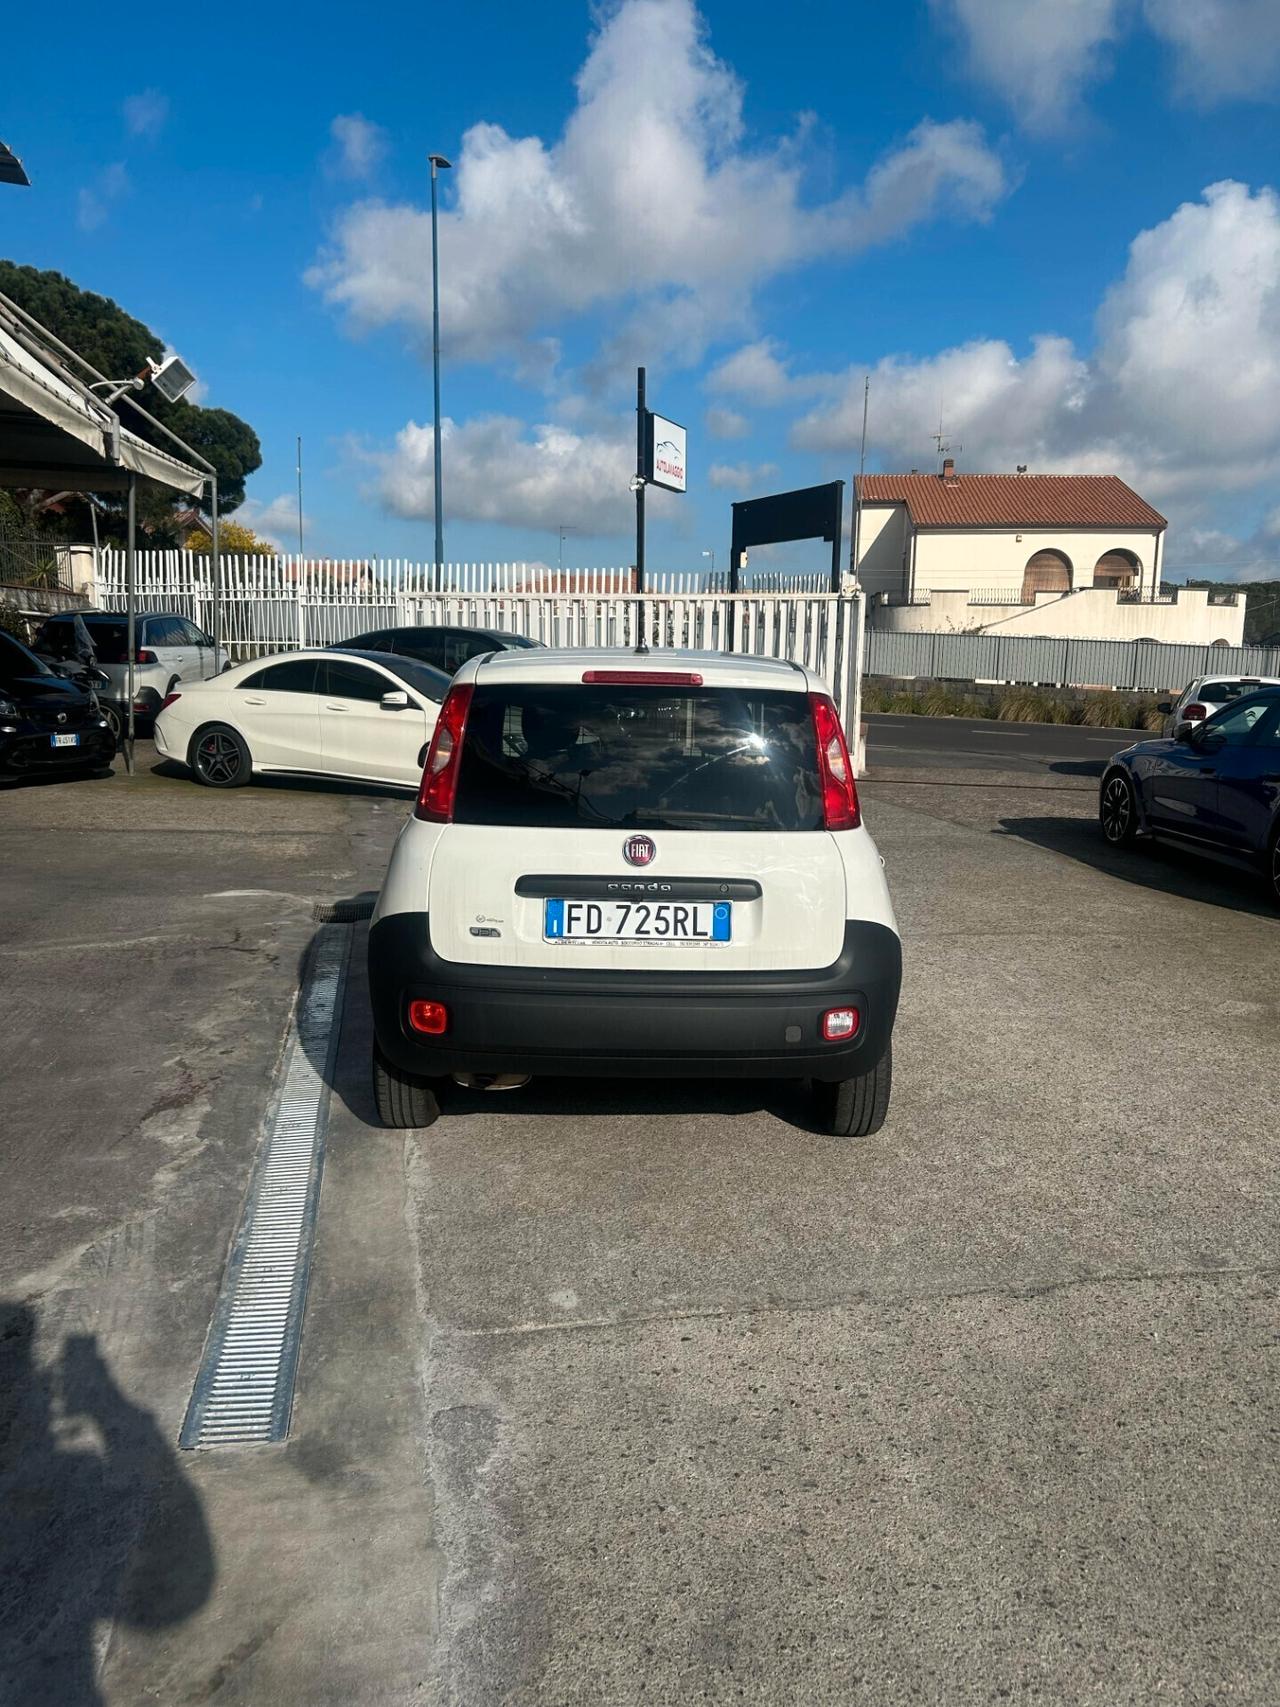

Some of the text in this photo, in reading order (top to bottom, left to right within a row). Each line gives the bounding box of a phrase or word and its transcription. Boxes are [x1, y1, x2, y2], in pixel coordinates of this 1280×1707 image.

[631, 843, 650, 858] FIAT
[567, 904, 708, 937] FD 725RL
